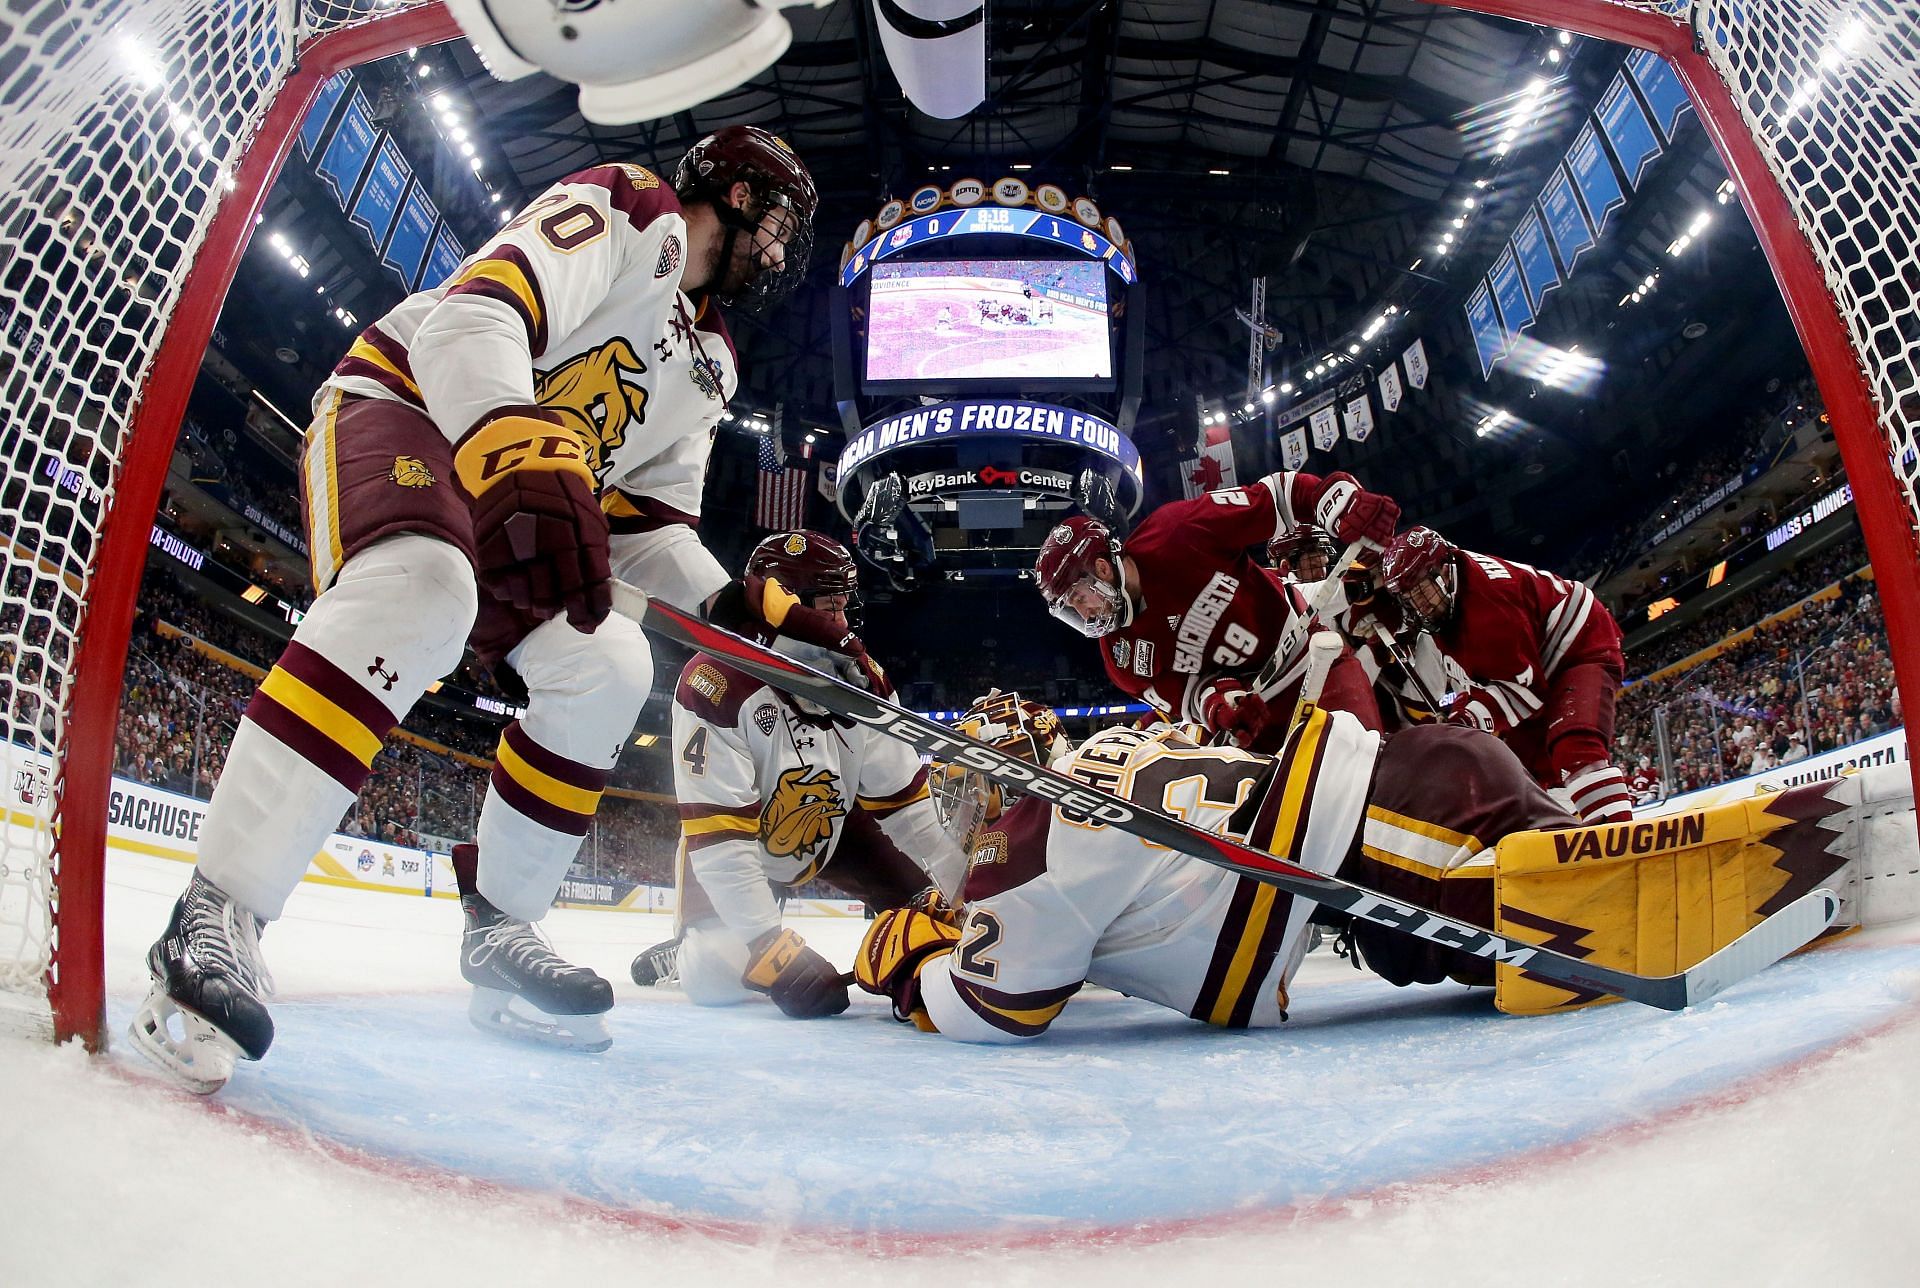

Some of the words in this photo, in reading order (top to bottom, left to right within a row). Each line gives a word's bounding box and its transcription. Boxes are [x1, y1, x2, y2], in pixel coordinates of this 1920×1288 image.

[380, 161, 399, 190] DENVER
[928, 219, 940, 235] 0
[977, 210, 1009, 224] 8:18
[1051, 221, 1061, 238] 1
[1386, 380, 1394, 394] 2
[1318, 420, 1332, 435] 11
[1353, 410, 1362, 424] 7
[841, 430, 875, 477] NCAA
[879, 408, 954, 449] MEN'S
[960, 404, 1065, 435] FROZEN
[1070, 415, 1121, 456] FOUR
[1288, 442, 1301, 456] 14
[908, 471, 977, 494] KeyBank
[1019, 470, 1073, 491] Center
[260, 515, 279, 534] NCAA
[278, 527, 299, 548] MEN'S
[1766, 515, 1802, 551] UMASS
[1213, 621, 1259, 667] 29
[690, 676, 718, 699] UMD
[475, 696, 506, 715] UMASS
[754, 706, 778, 722] NCHC
[682, 724, 709, 779] 4
[847, 705, 1134, 824] JETSPEED
[108, 791, 206, 842] SACHUSE
[1553, 812, 1705, 864] VAUGHN
[571, 882, 596, 900] FROZEN
[597, 884, 615, 901] FOUR
[1347, 889, 1538, 967] CCM
[958, 908, 1004, 982] 2
